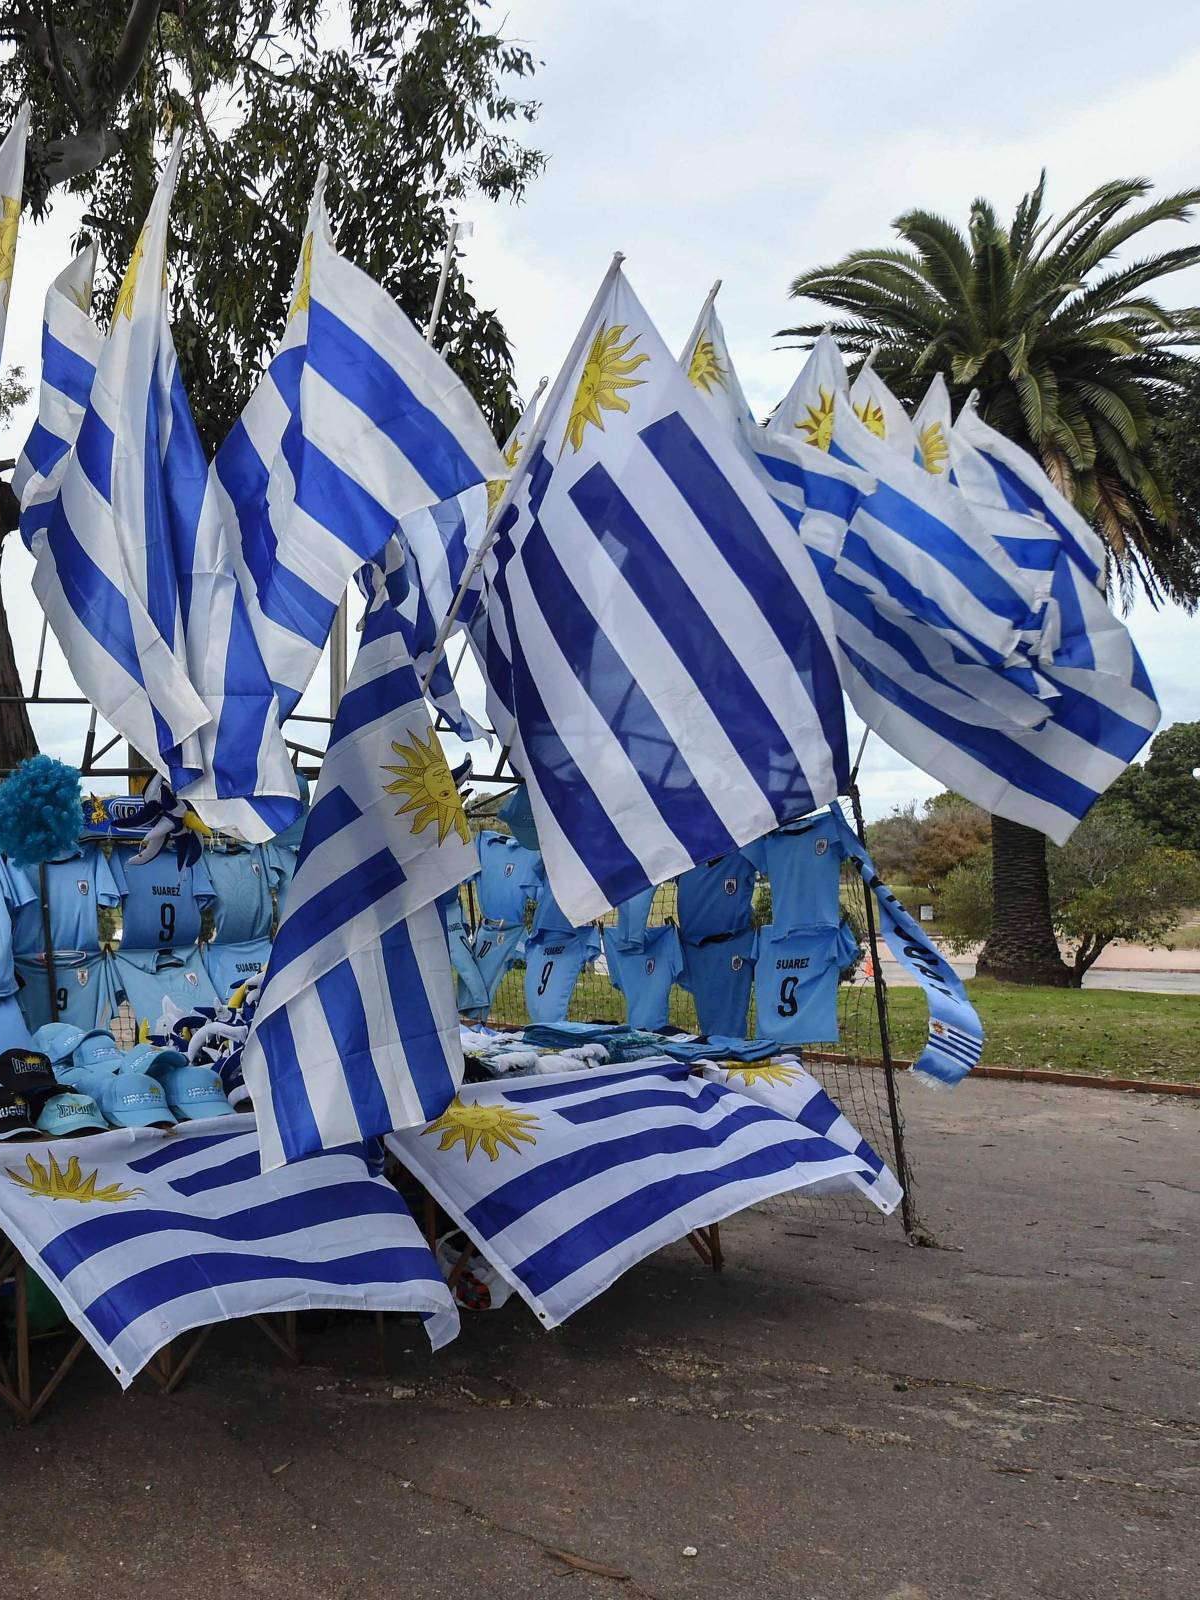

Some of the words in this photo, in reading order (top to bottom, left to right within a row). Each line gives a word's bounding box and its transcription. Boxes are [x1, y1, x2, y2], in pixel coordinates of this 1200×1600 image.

[152, 885, 181, 897] SUAREZ
[159, 903, 176, 942] 9
[477, 940, 493, 959] 10
[776, 957, 810, 970] SUAREZ
[538, 961, 554, 996] 9
[57, 987, 68, 1011] 9
[777, 976, 799, 1018] 9
